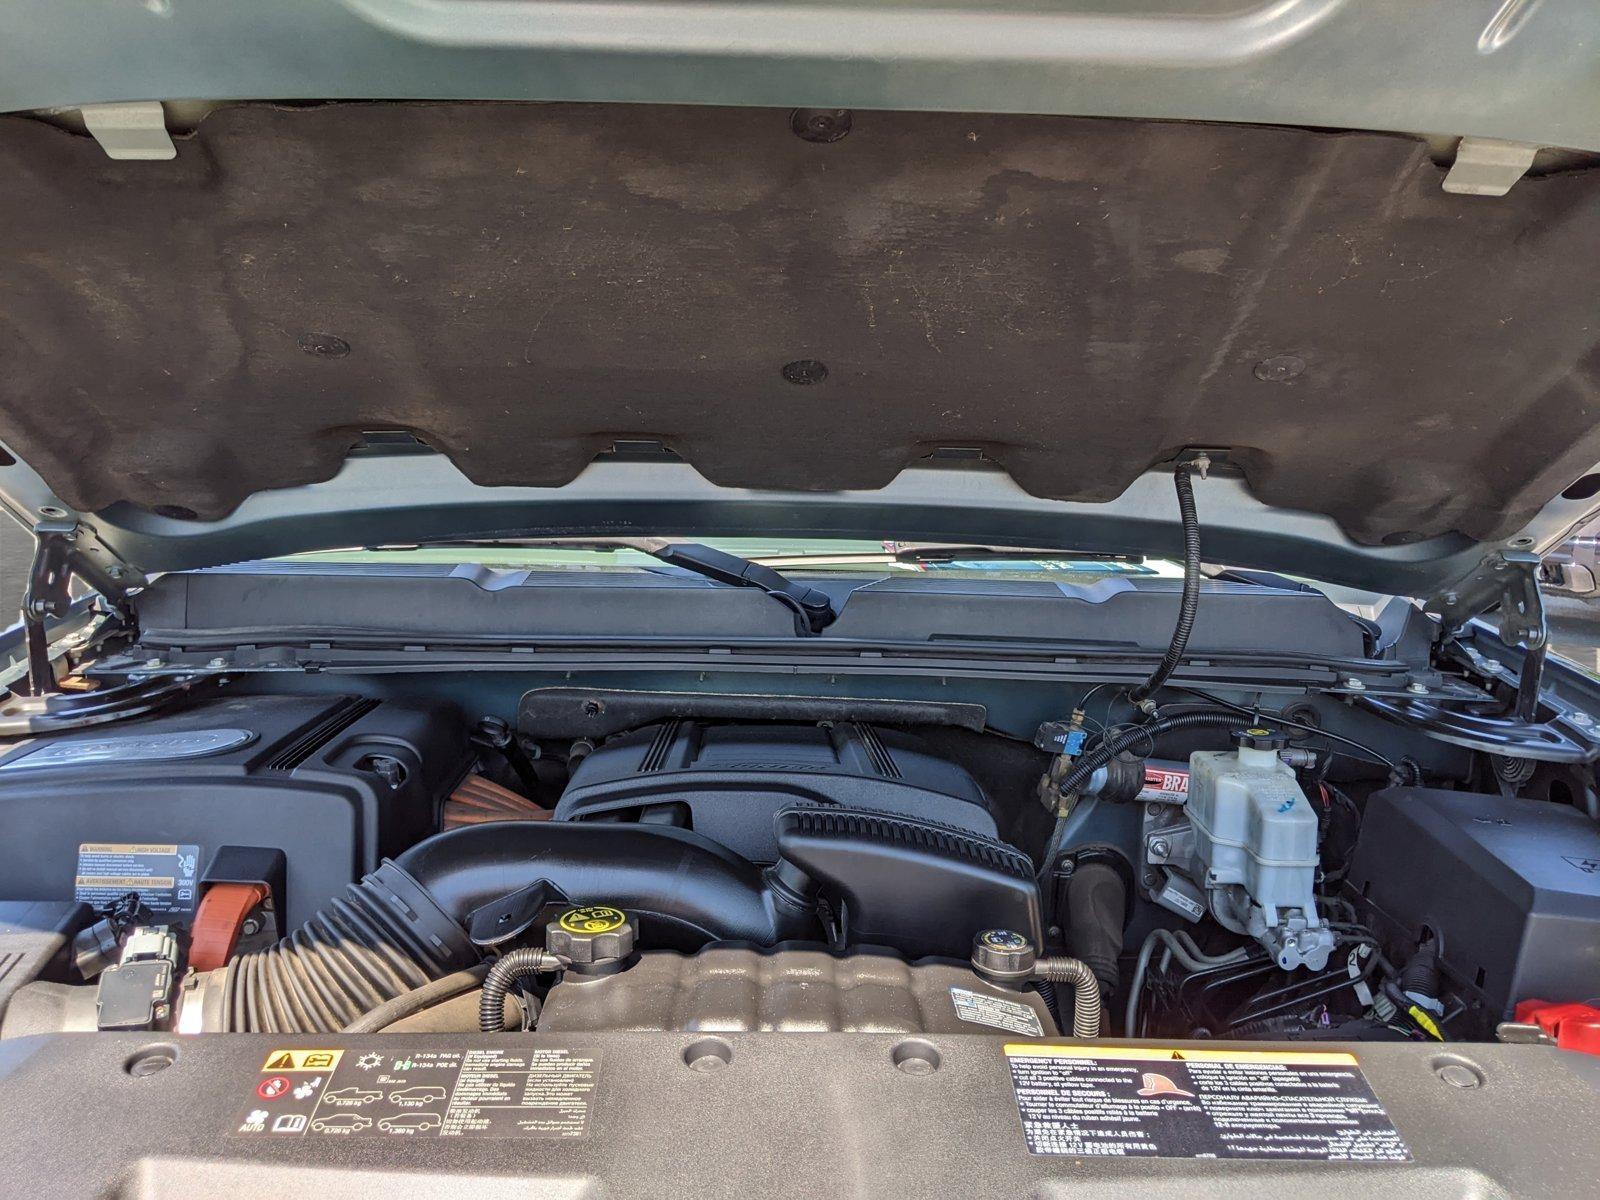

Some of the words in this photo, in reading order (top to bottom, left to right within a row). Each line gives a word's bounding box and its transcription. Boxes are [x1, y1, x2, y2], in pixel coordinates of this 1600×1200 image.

[1349, 952, 1356, 967] 2
[1009, 1057, 1052, 1065] EMERGENCY
[1053, 1058, 1097, 1066] PERSONNEL:
[238, 1123, 265, 1131] AUTO
